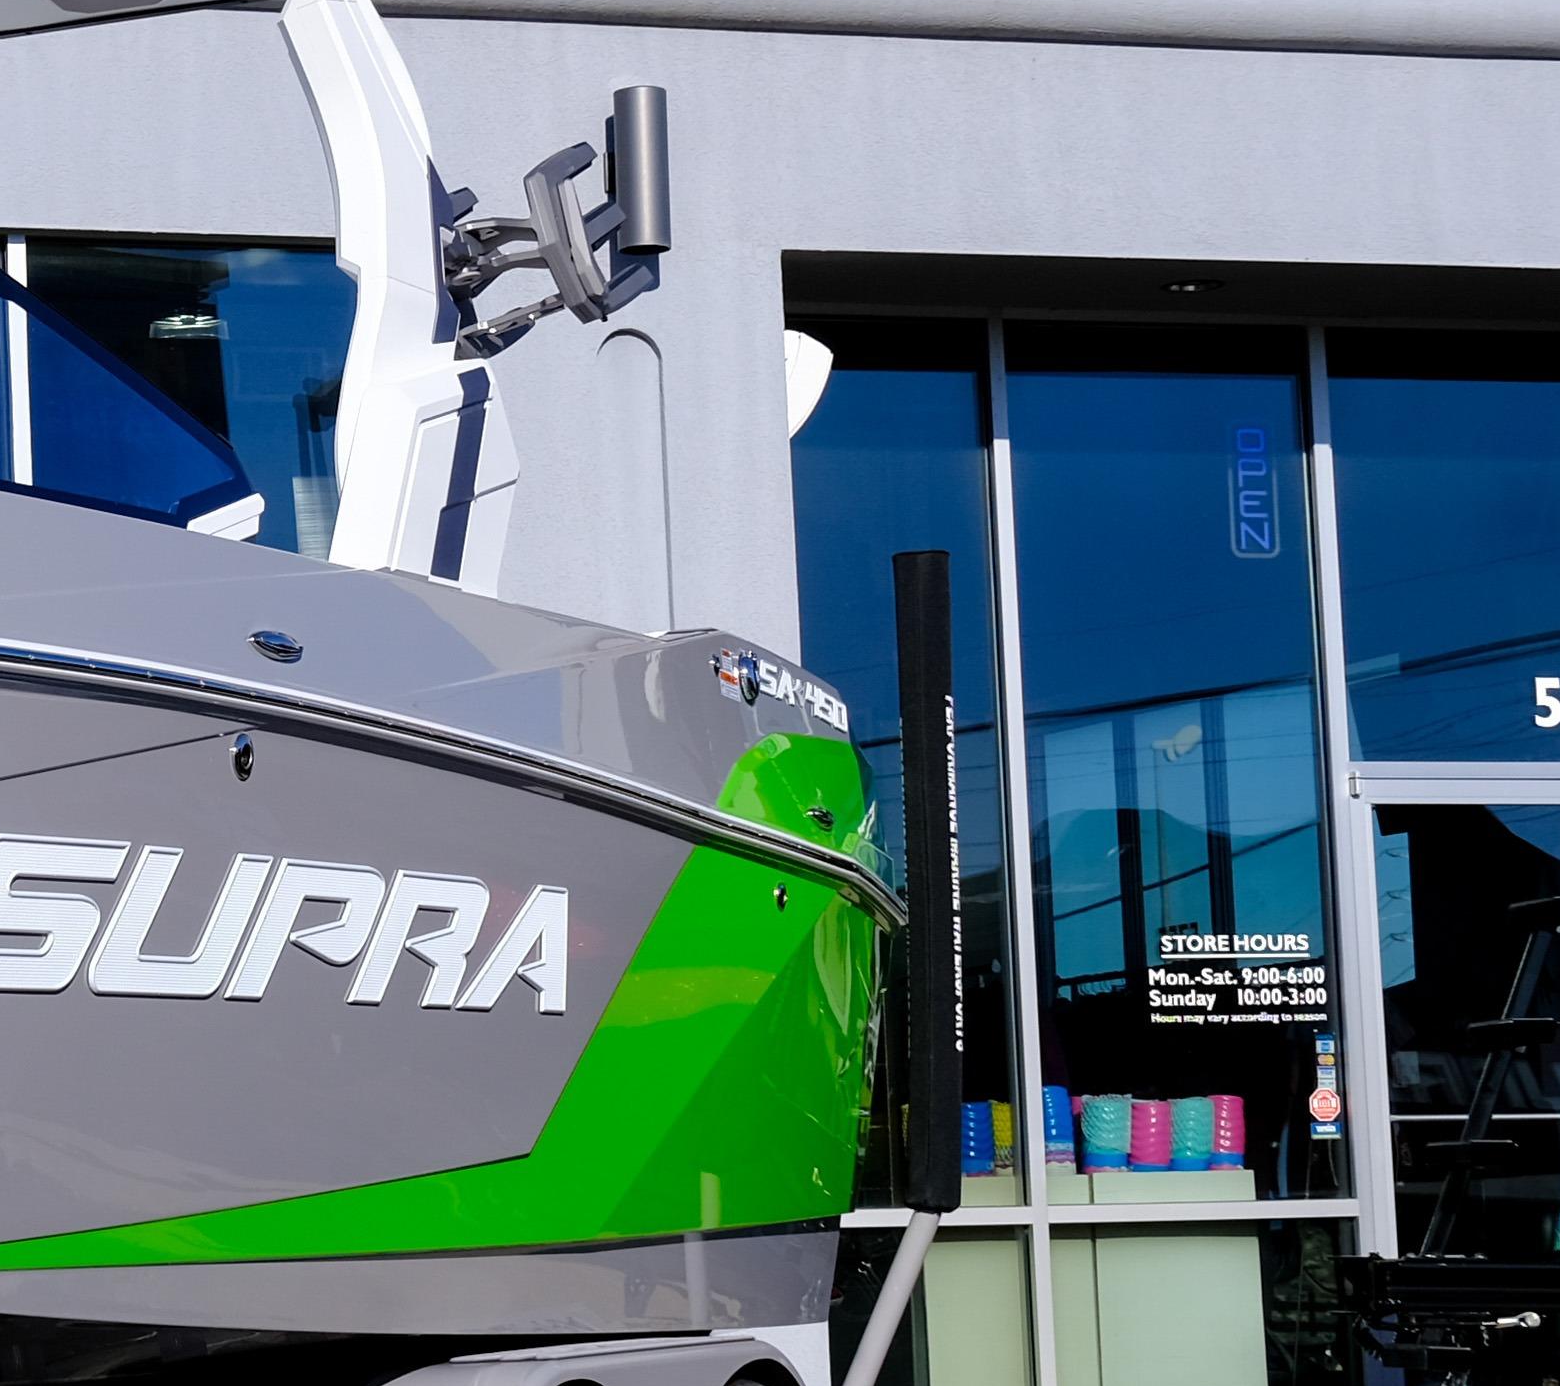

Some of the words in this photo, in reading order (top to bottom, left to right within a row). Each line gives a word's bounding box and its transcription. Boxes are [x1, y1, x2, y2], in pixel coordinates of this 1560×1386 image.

[1236, 428, 1271, 551] OPEN
[1160, 934, 1230, 953] STORE
[1233, 934, 1310, 952] HOURS
[1147, 967, 1238, 986] Mon.-Sat.
[1241, 966, 1326, 986] 9:00-6:00
[1148, 988, 1217, 1011] Sunday
[1237, 987, 1328, 1006] 10:00-3:00
[1150, 1013, 1183, 1024] Hours
[1183, 1015, 1206, 1025] may
[1207, 1014, 1230, 1025] vary
[1281, 1013, 1293, 1022] to
